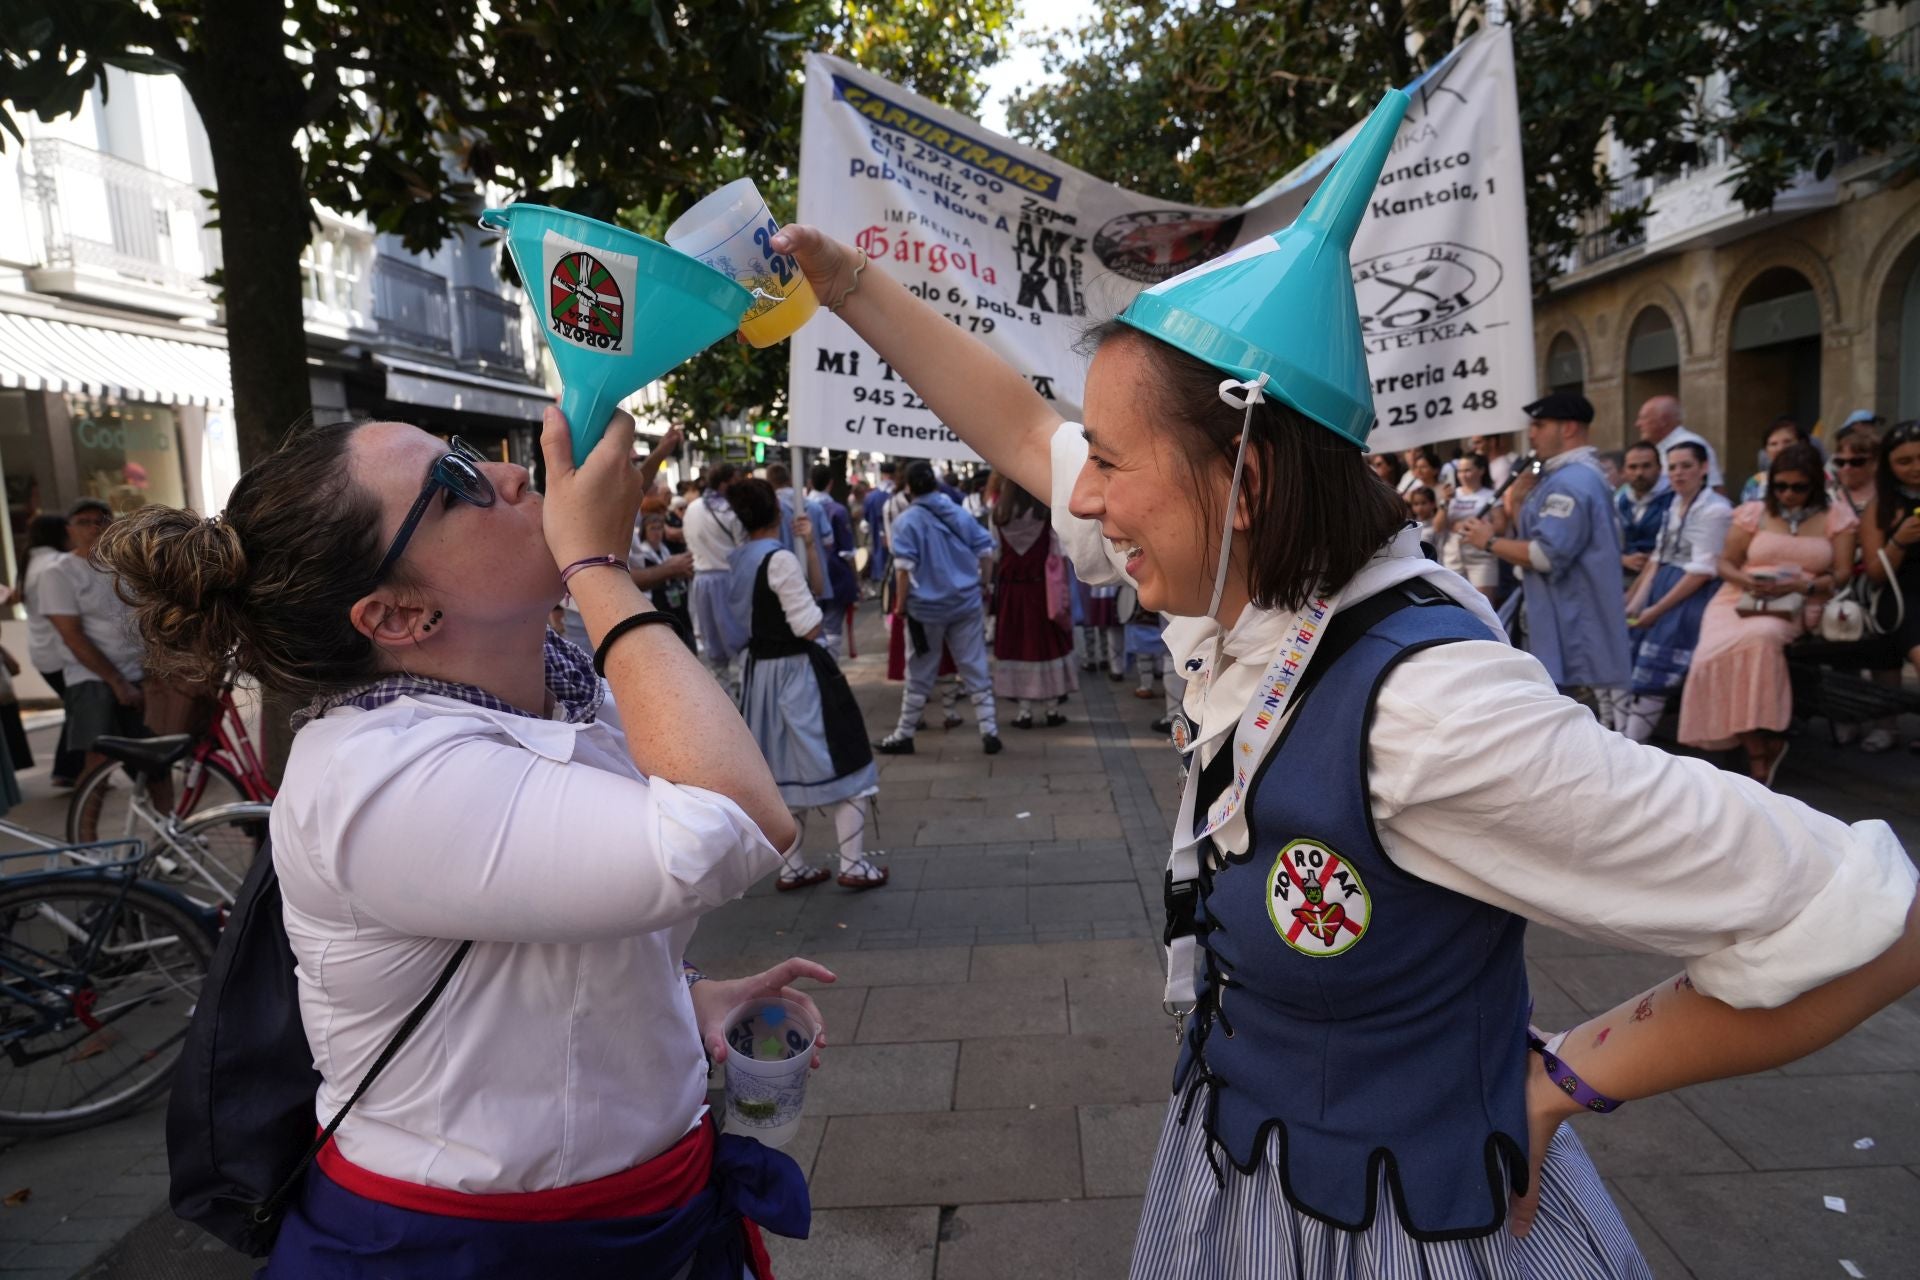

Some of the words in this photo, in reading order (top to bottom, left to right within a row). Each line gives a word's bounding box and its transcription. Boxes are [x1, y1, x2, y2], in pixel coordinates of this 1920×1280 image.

[913, 143, 952, 171] 292
[959, 168, 1004, 194] 400
[1378, 152, 1471, 186] ancisco
[933, 191, 989, 225] Nave
[995, 216, 1010, 232] A
[975, 193, 988, 205] 4
[1372, 181, 1479, 219] Kantoia,
[1486, 178, 1496, 195] 1
[884, 208, 972, 248] IMPRENTA
[855, 225, 997, 285] Gárgola
[902, 281, 940, 300] olo
[947, 288, 968, 307] 6,
[976, 295, 1023, 320] pab.
[1030, 312, 1042, 325] 8
[1360, 292, 1470, 332] ROSI
[552, 317, 622, 351] ZOROAK
[968, 315, 996, 334] 79
[815, 348, 860, 376] Mi
[1370, 363, 1445, 394] rreria
[1452, 357, 1489, 379] 44
[853, 386, 896, 406] 945
[1388, 403, 1418, 427] 25
[1424, 396, 1453, 419] 02
[1462, 390, 1498, 411] 48
[845, 415, 865, 434] c/
[1258, 616, 1304, 699] FARMACIA
